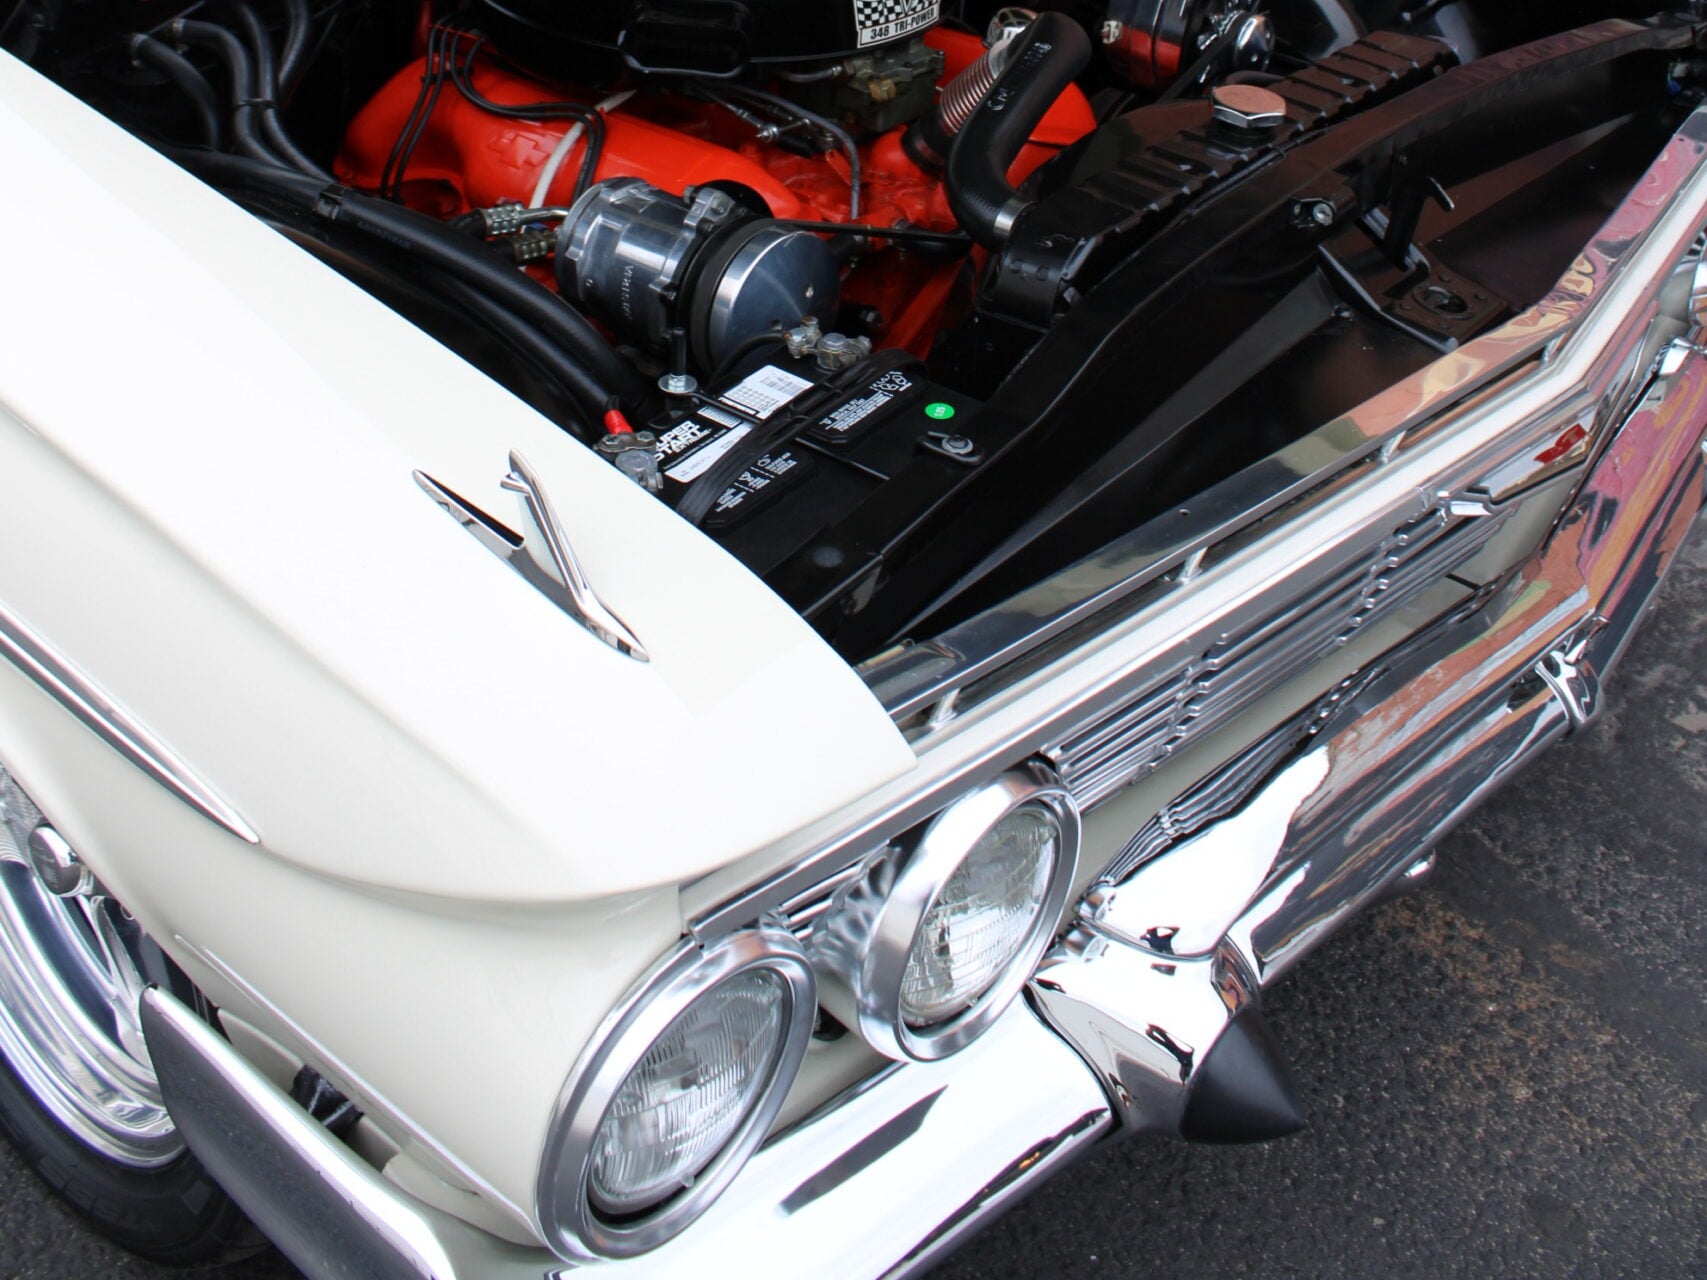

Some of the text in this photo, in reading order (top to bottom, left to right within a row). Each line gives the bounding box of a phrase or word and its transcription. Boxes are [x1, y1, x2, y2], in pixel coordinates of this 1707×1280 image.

[870, 7, 935, 40] 348 TRI-POWER
[656, 420, 696, 449] UPER
